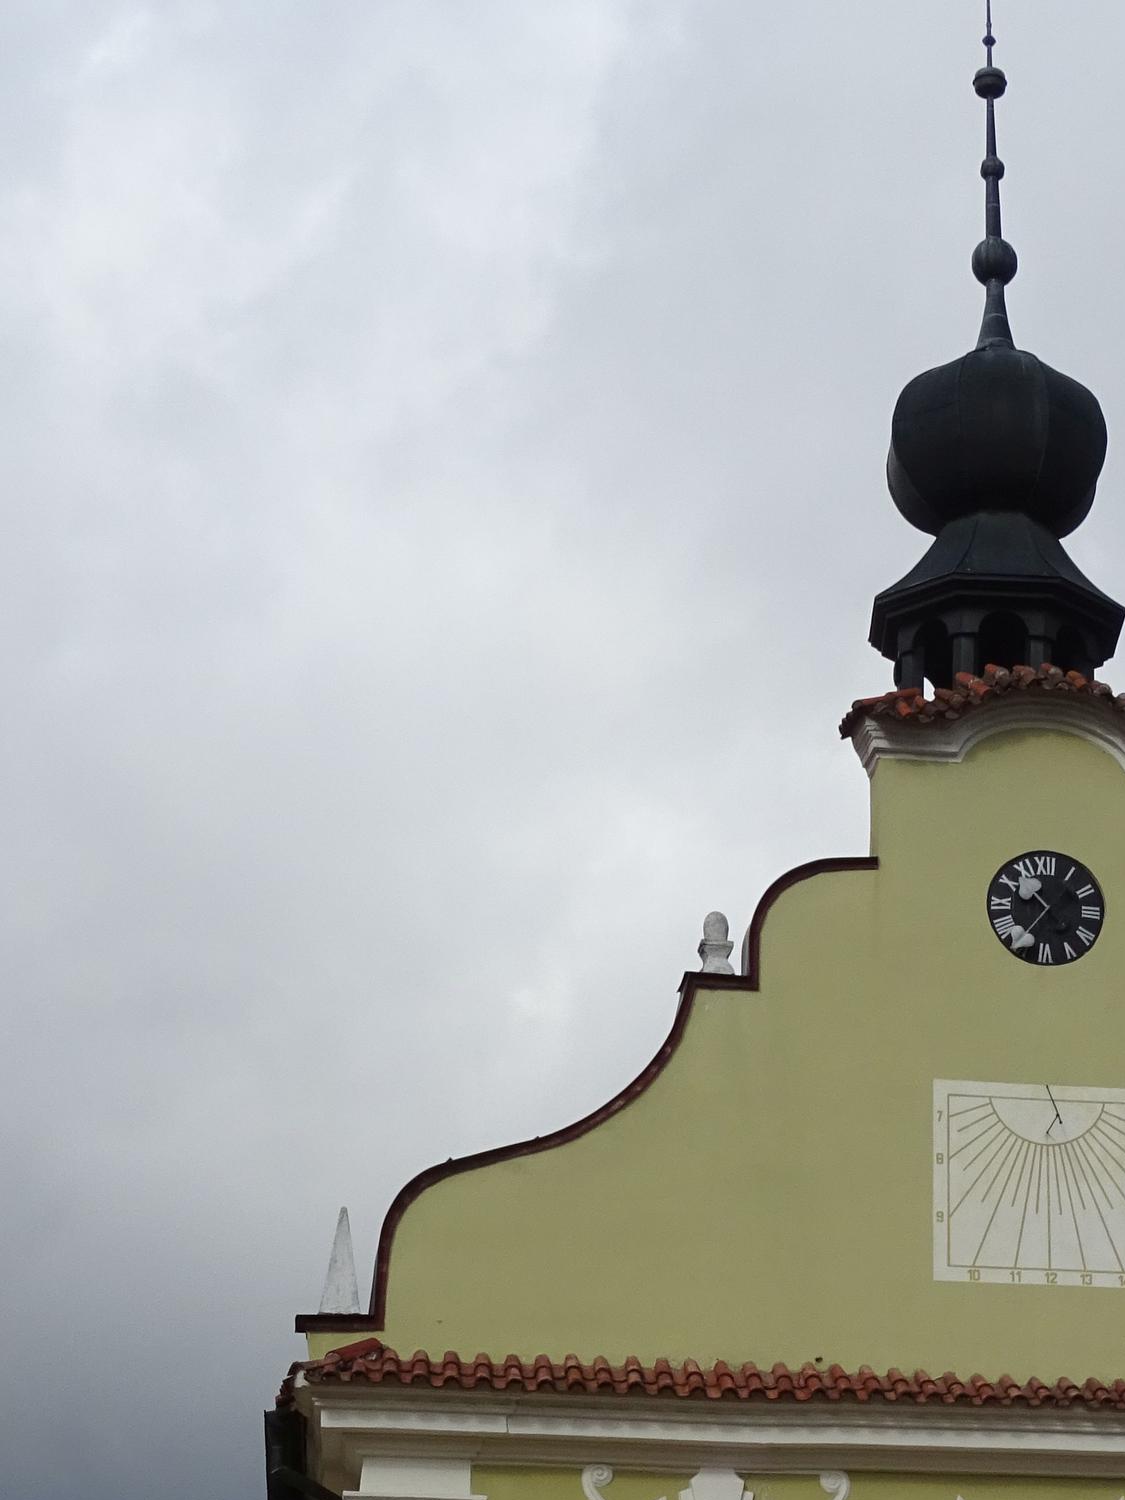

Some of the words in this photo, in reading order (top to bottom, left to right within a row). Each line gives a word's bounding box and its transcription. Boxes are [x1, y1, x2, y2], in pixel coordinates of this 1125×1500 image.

[1013, 858, 1035, 877] XI
[1034, 856, 1056, 876] XII
[999, 874, 1019, 892] X
[1076, 884, 1095, 899] II
[991, 896, 1011, 909] IX
[1081, 905, 1101, 920] III
[936, 1110, 944, 1122] 7
[936, 1153, 944, 1165] 8
[936, 1211, 944, 1223] 9
[968, 1269, 981, 1282] 10
[1010, 1270, 1022, 1283] 11
[1045, 1272, 1058, 1285] 12
[1080, 1274, 1093, 1287] 13
